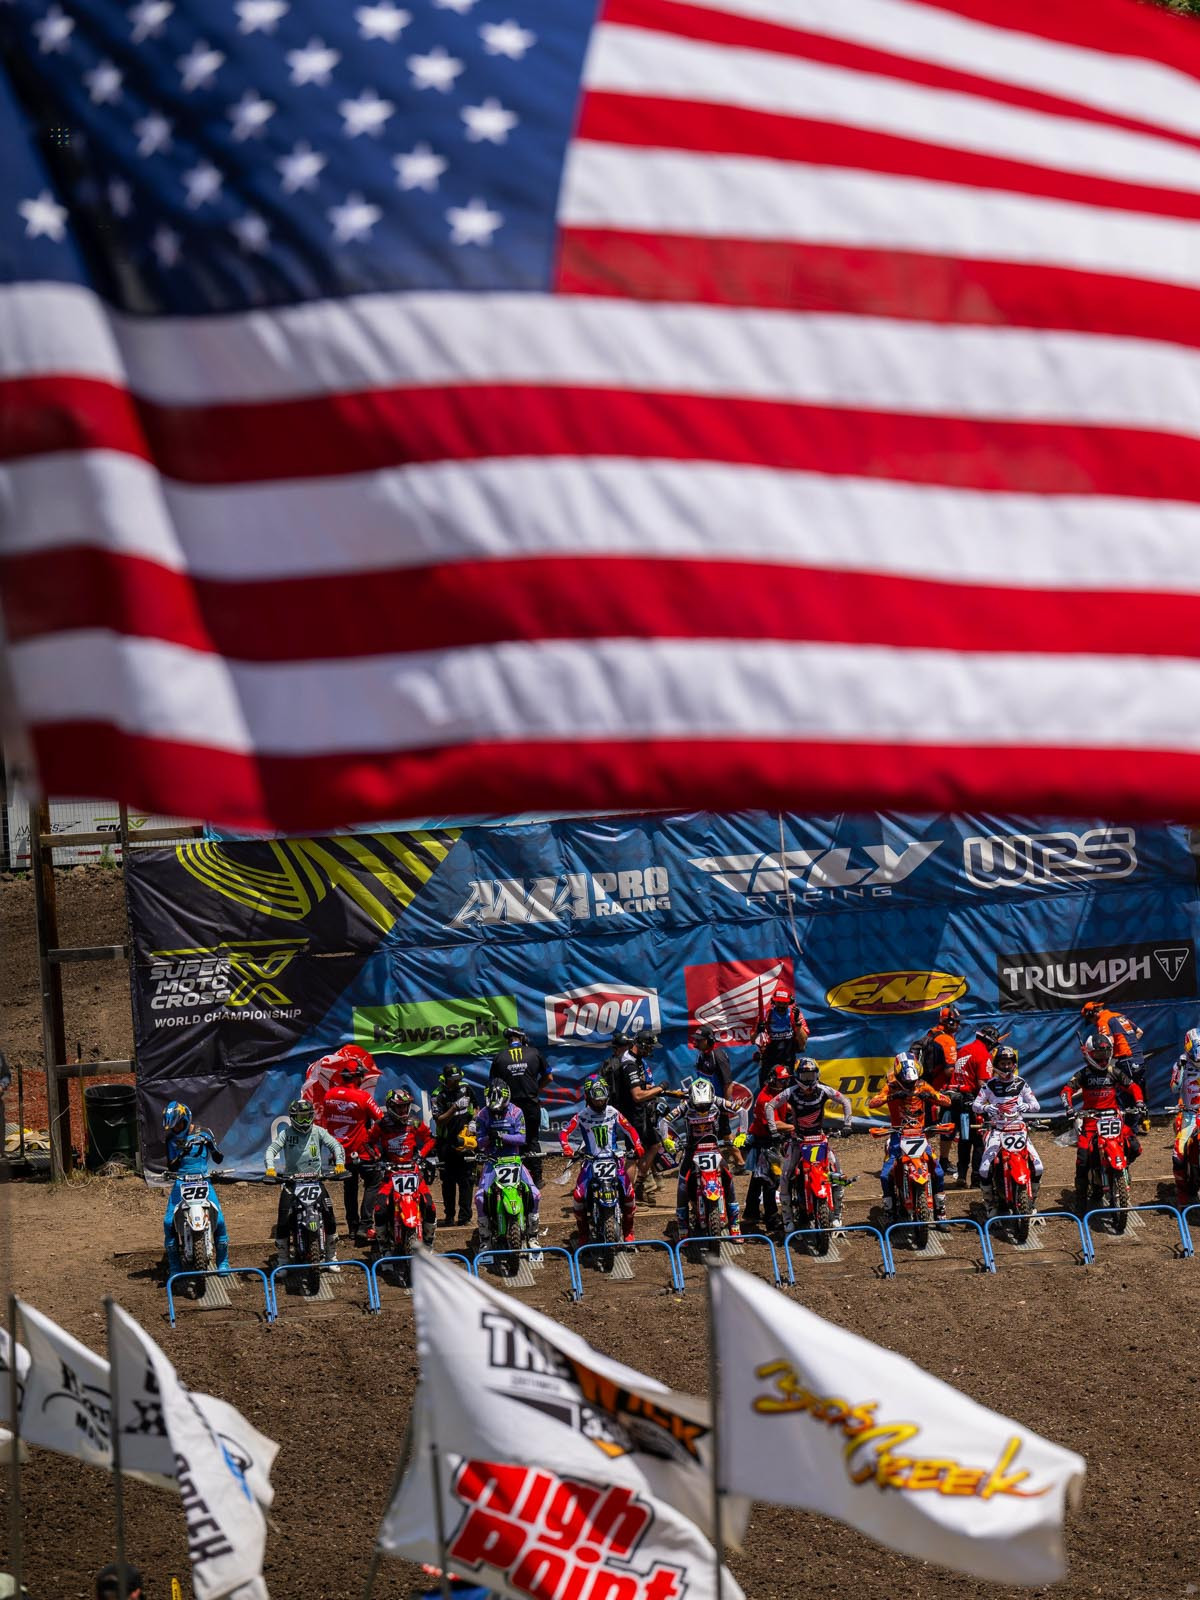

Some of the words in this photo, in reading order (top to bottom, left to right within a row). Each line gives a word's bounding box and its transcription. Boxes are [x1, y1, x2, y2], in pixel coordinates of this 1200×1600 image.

[688, 840, 945, 893] FLY
[963, 827, 1138, 889] WPS
[442, 873, 592, 929] AMA
[592, 867, 669, 900] PRO
[746, 885, 893, 906] RACING
[596, 896, 671, 917] RACING
[150, 957, 231, 981] SUPER
[1003, 956, 1151, 998] TRIUMPH
[155, 974, 229, 995] MOTO
[829, 976, 967, 1008] FMF
[150, 989, 231, 1010] CROSS
[155, 1014, 201, 1028] WORLD
[204, 1009, 302, 1023] CHAMPIONSHIP
[563, 997, 645, 1036] 100%
[372, 1015, 500, 1044] Kawasaki
[907, 1139, 925, 1155] 7
[1003, 1135, 1026, 1150] 96
[698, 1153, 717, 1171] 51
[809, 1146, 819, 1162] 1
[498, 1166, 520, 1185] 21
[593, 1162, 616, 1178] 32
[182, 1186, 209, 1201] 28
[298, 1185, 320, 1201] 46
[395, 1176, 417, 1193] 14
